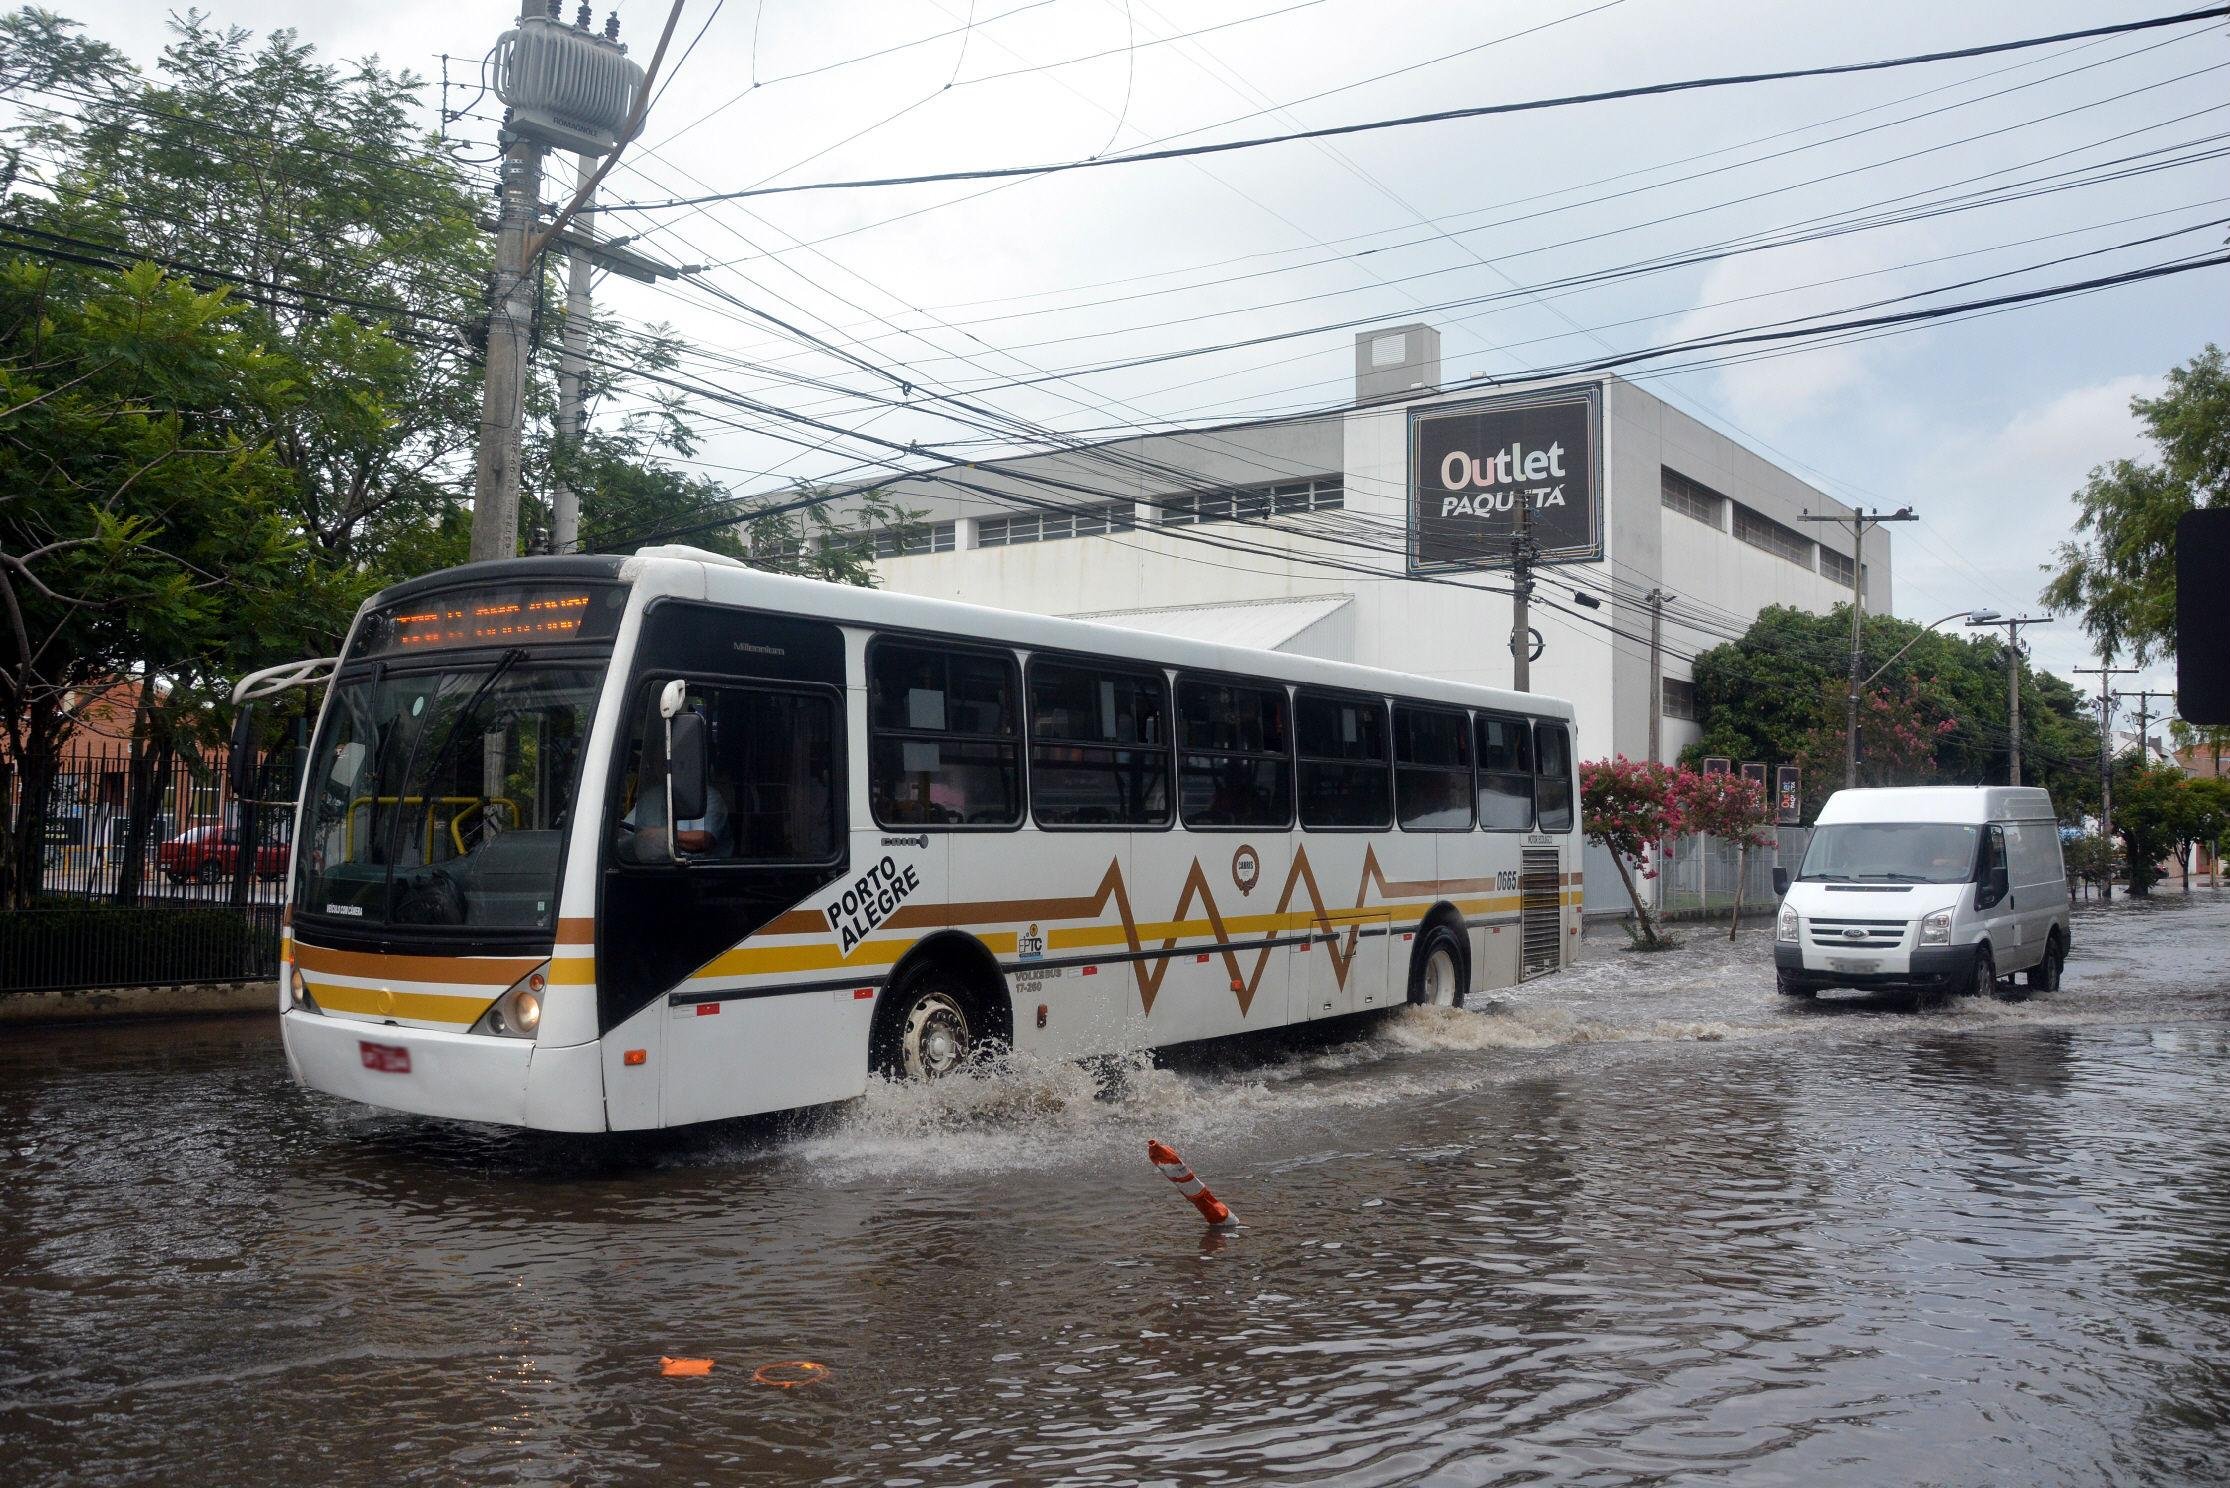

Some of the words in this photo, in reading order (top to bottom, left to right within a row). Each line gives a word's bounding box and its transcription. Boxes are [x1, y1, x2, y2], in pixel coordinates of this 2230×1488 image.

[1441, 441, 1566, 490] Outlet
[1441, 484, 1566, 517] PAQUTÁ
[1781, 781, 1790, 808] Oulet
[827, 856, 896, 930] PORTO
[1496, 870, 1517, 891] 0665
[841, 864, 920, 954] ALEGRE
